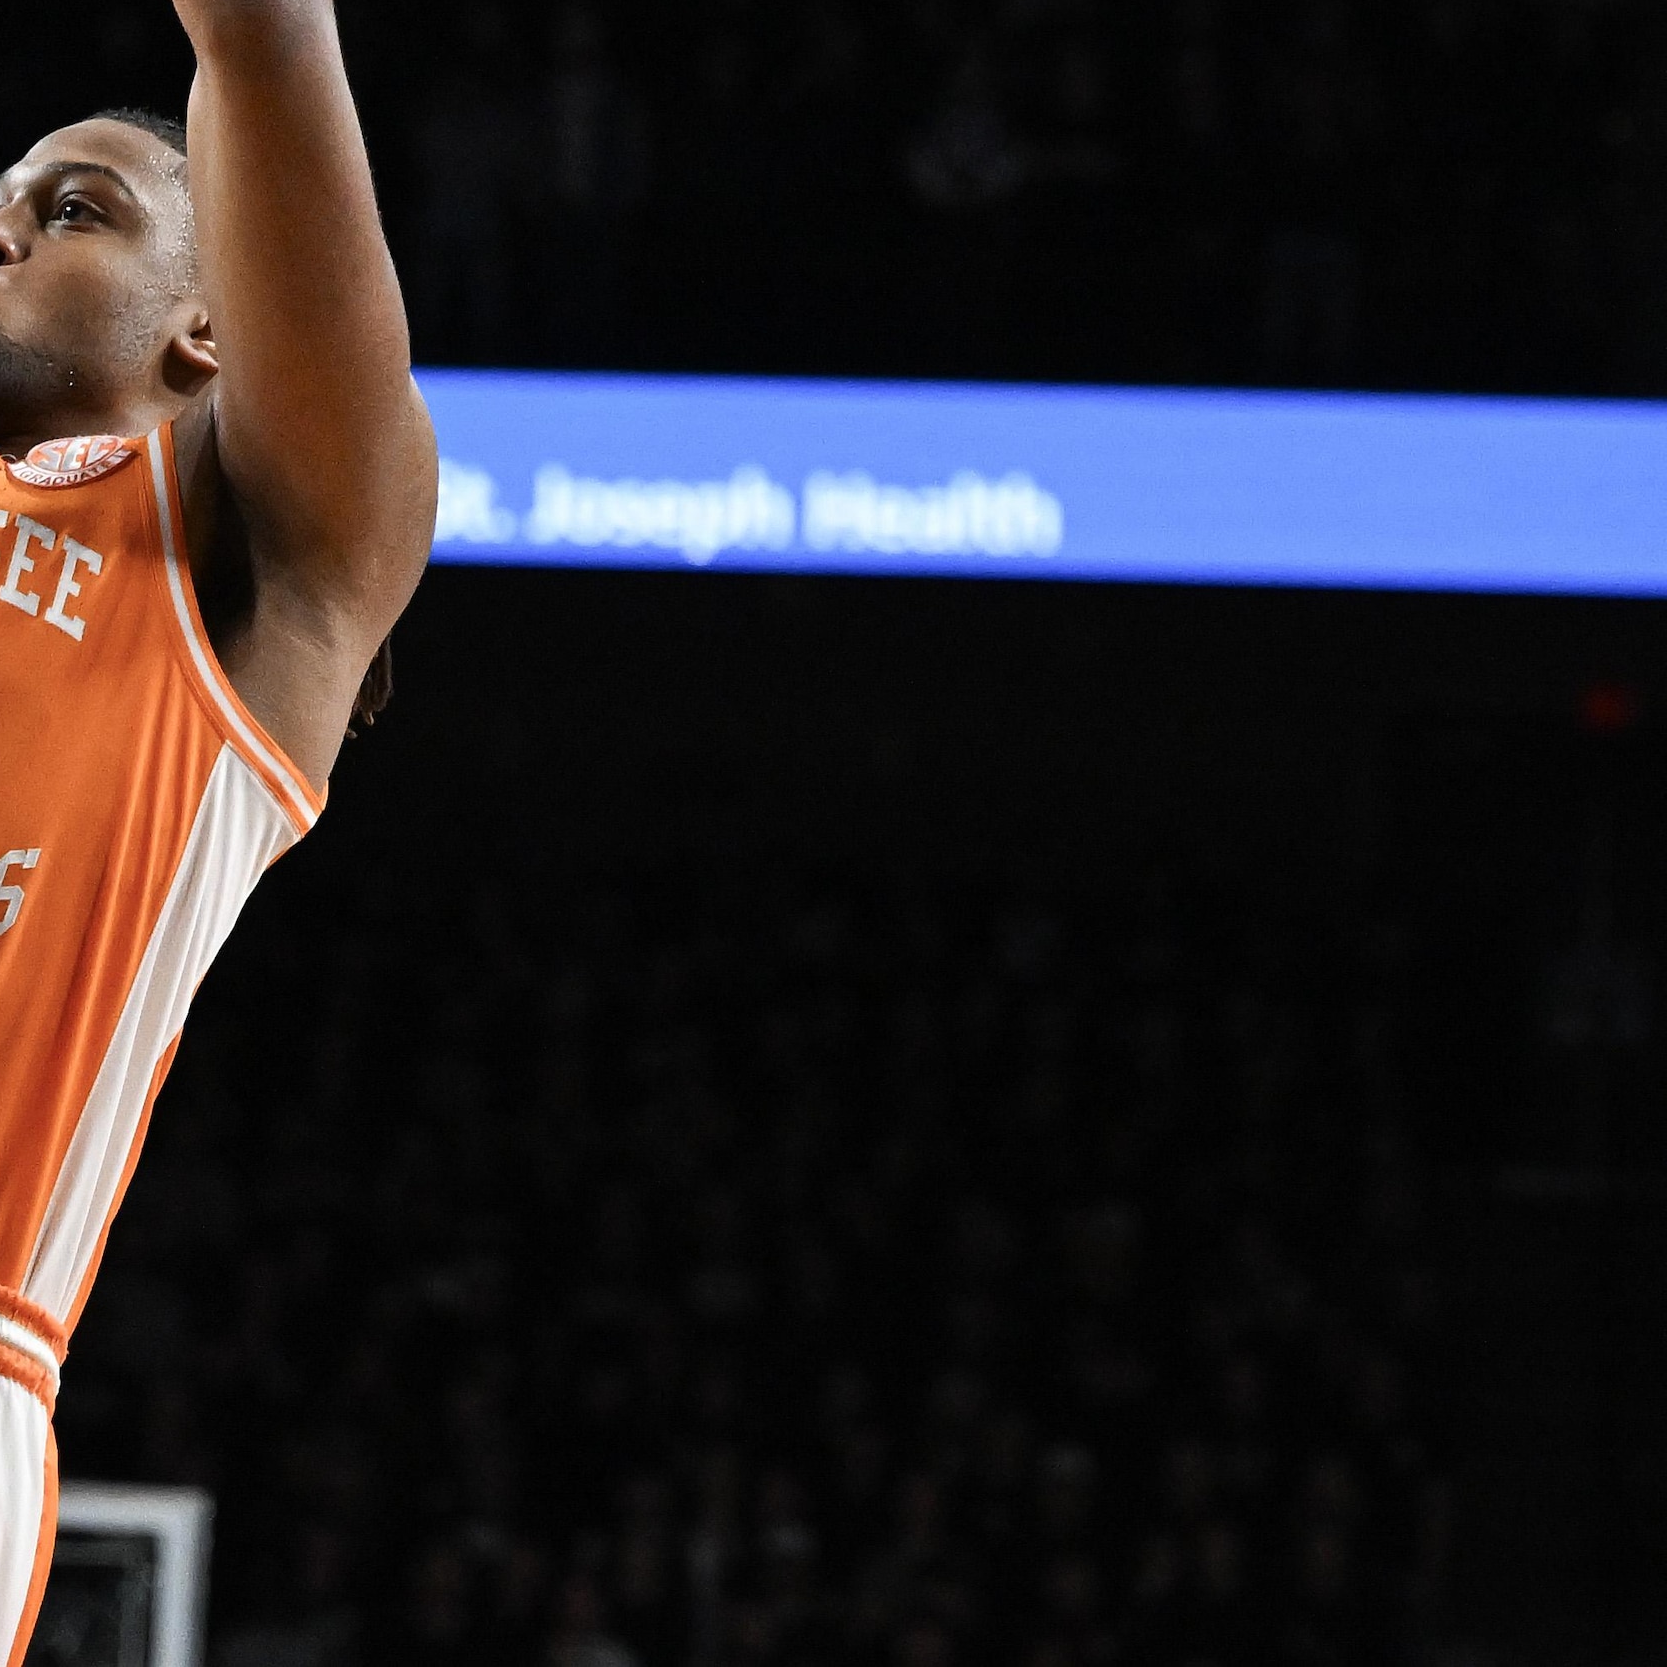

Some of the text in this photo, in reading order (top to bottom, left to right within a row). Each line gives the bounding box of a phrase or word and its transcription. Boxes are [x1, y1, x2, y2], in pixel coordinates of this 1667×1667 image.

[33, 436, 116, 472] SEC
[523, 461, 798, 567] Joseph
[801, 468, 1066, 559] Health
